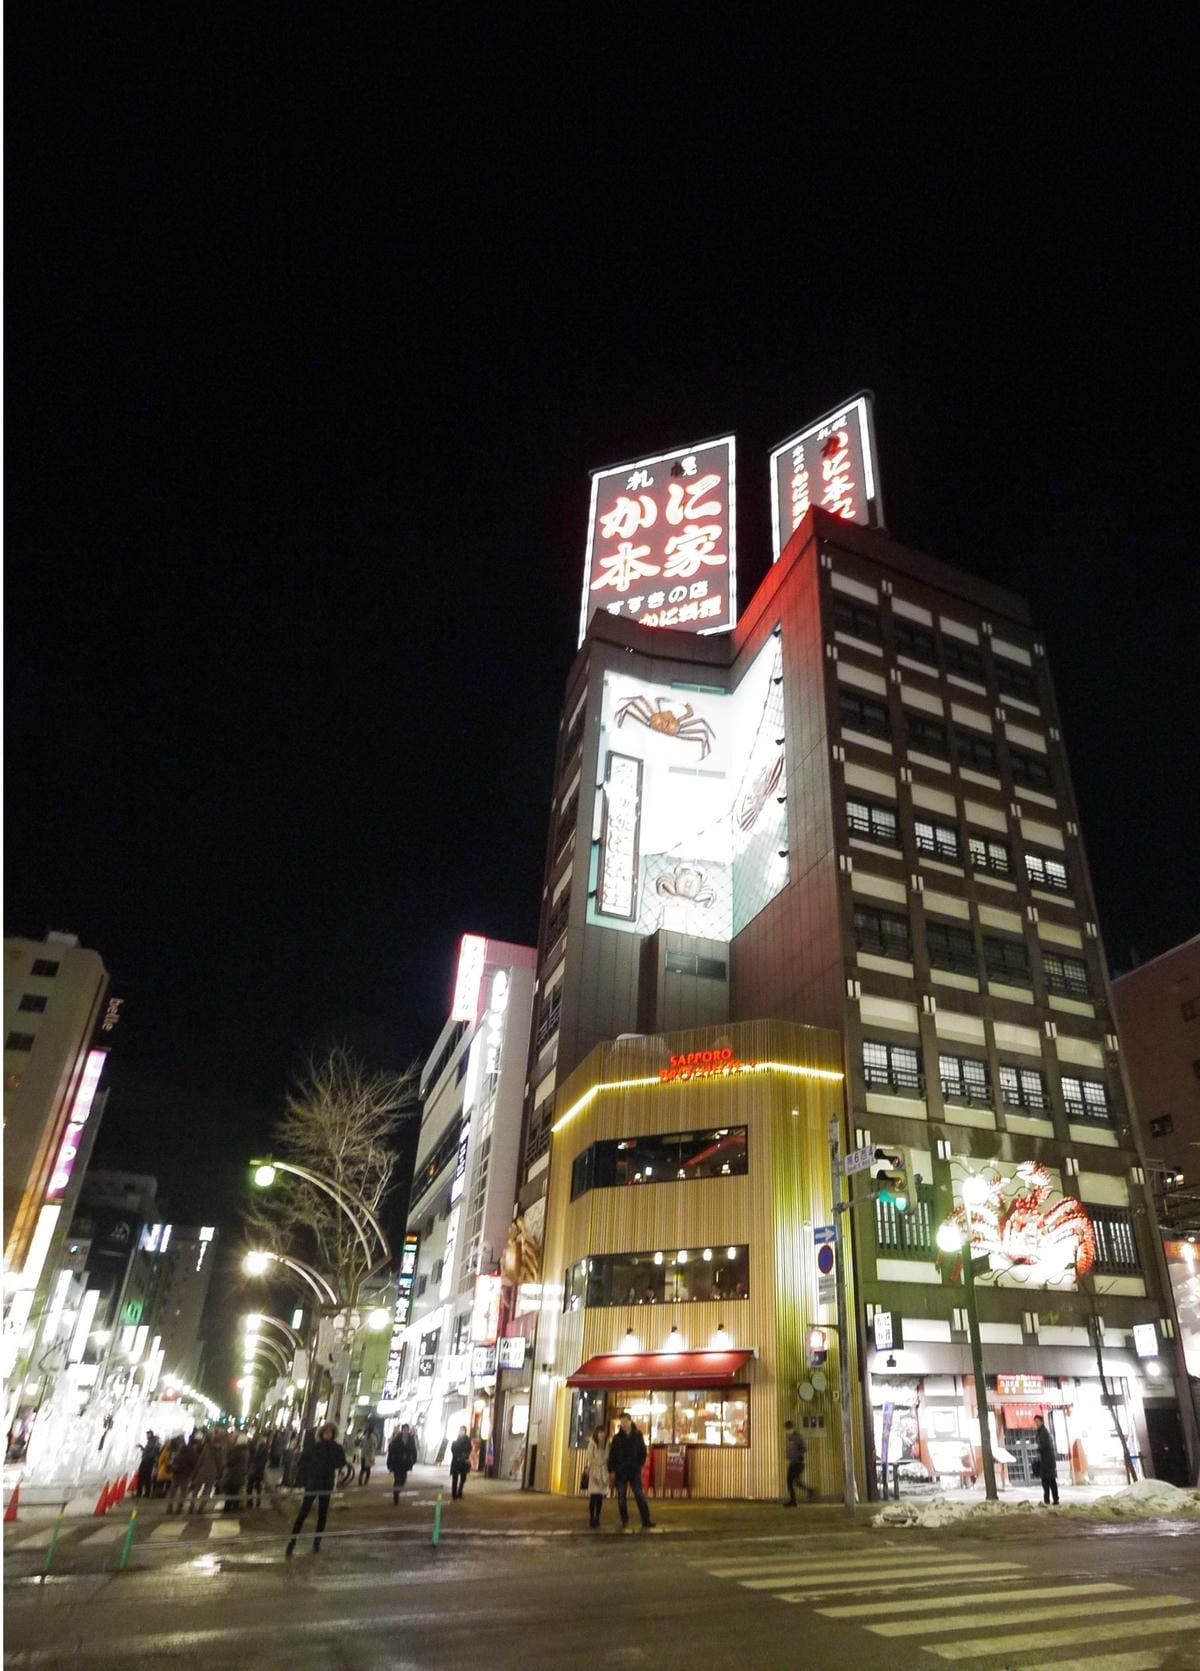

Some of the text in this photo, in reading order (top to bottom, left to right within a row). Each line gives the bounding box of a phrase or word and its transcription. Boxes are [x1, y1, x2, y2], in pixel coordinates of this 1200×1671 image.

[600, 474, 722, 539] かに
[590, 525, 727, 592] 本家
[670, 1047, 732, 1067] SAPPORO
